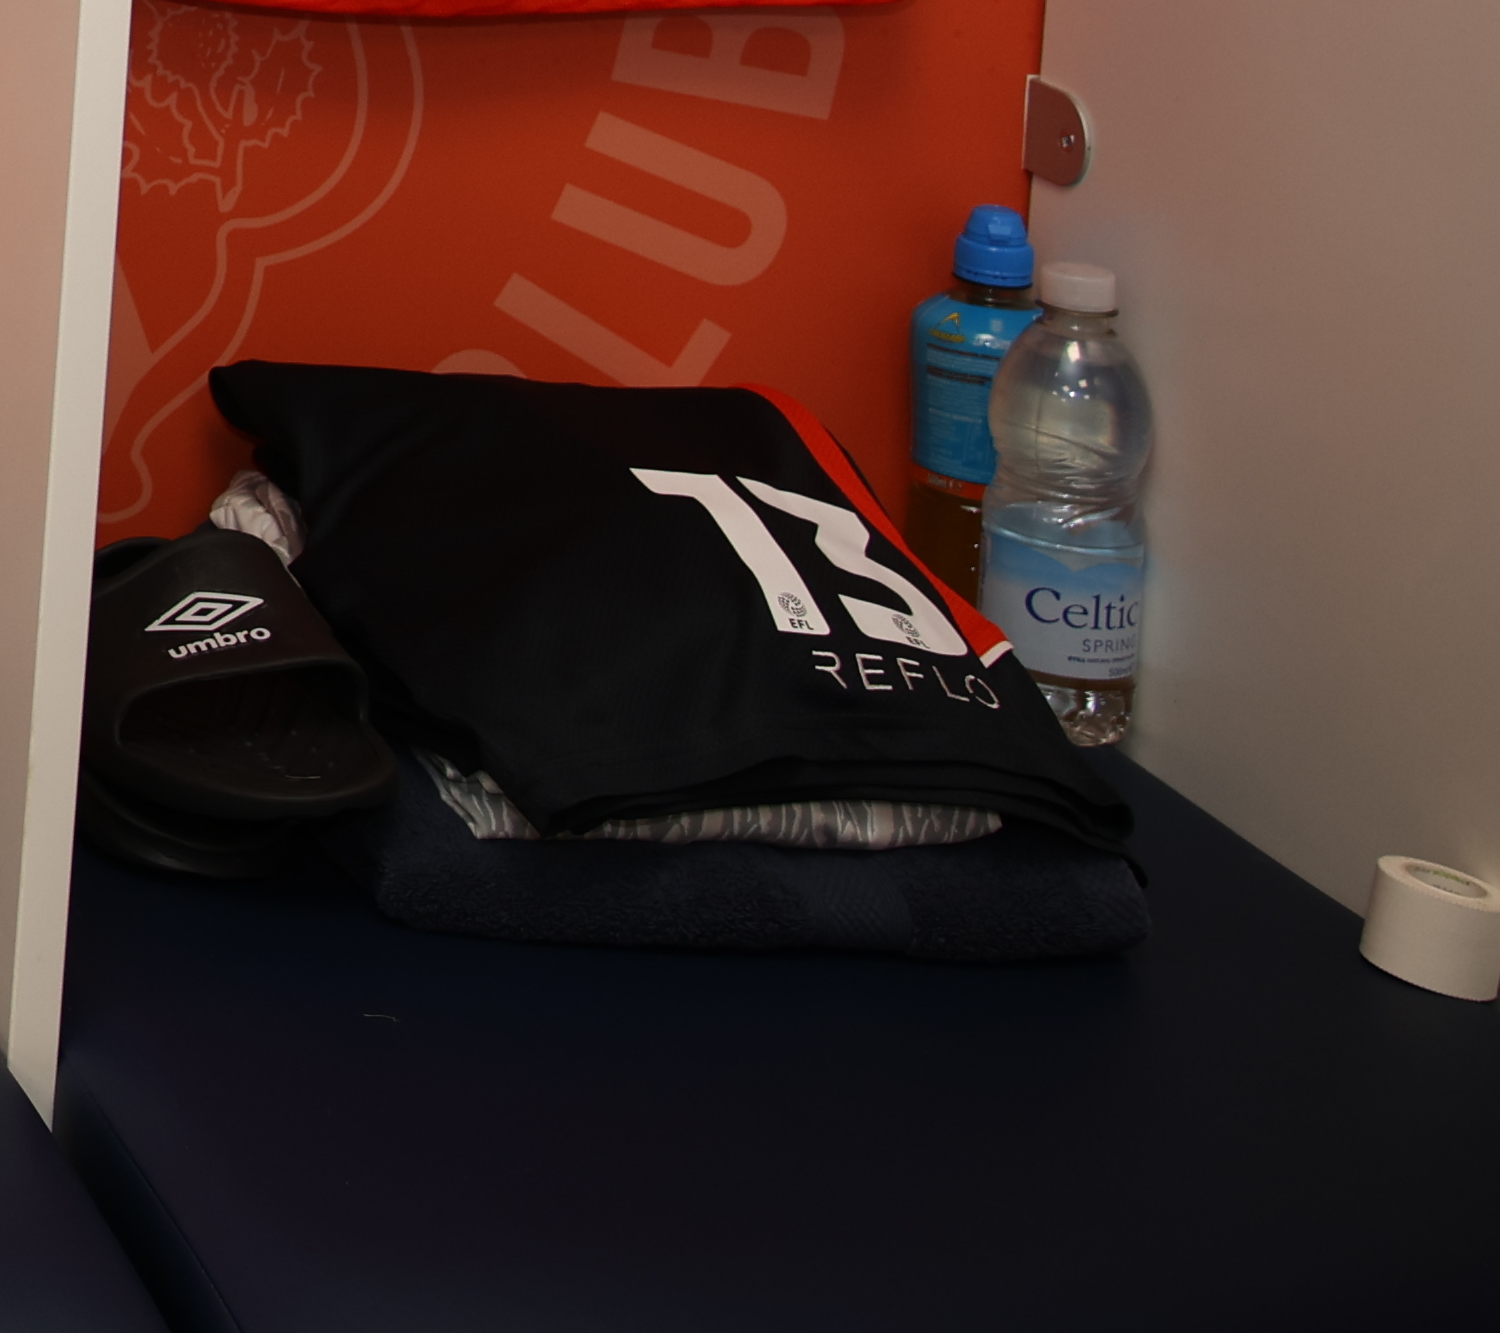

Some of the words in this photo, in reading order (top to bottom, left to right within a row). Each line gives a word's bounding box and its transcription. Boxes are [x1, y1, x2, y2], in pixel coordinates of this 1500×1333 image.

[628, 467, 968, 656] 13
[788, 617, 815, 631] EFL
[1025, 586, 1138, 631] Celtic
[167, 627, 271, 659] umbro
[906, 636, 930, 650] EFL
[811, 649, 1000, 709] REFLO
